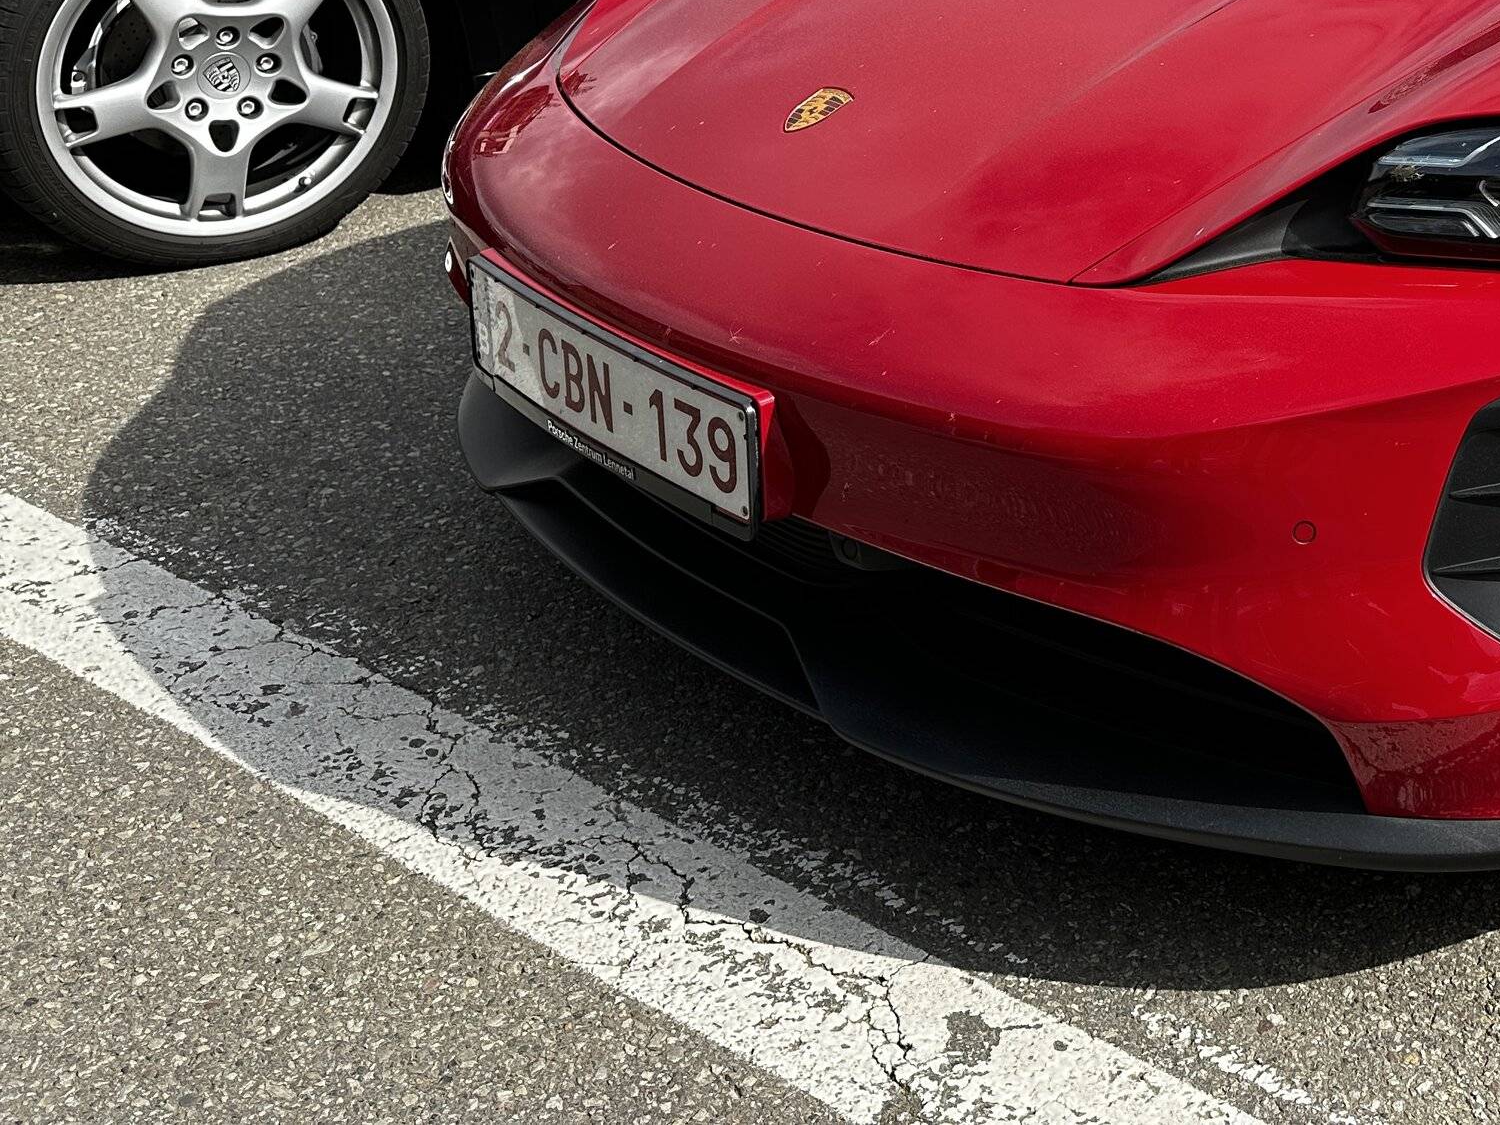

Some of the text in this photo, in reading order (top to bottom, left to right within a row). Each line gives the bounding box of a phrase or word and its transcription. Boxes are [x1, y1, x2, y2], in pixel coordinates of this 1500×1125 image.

[478, 321, 490, 355] B
[547, 419, 635, 480] Porsche Zentrum Lennetal
